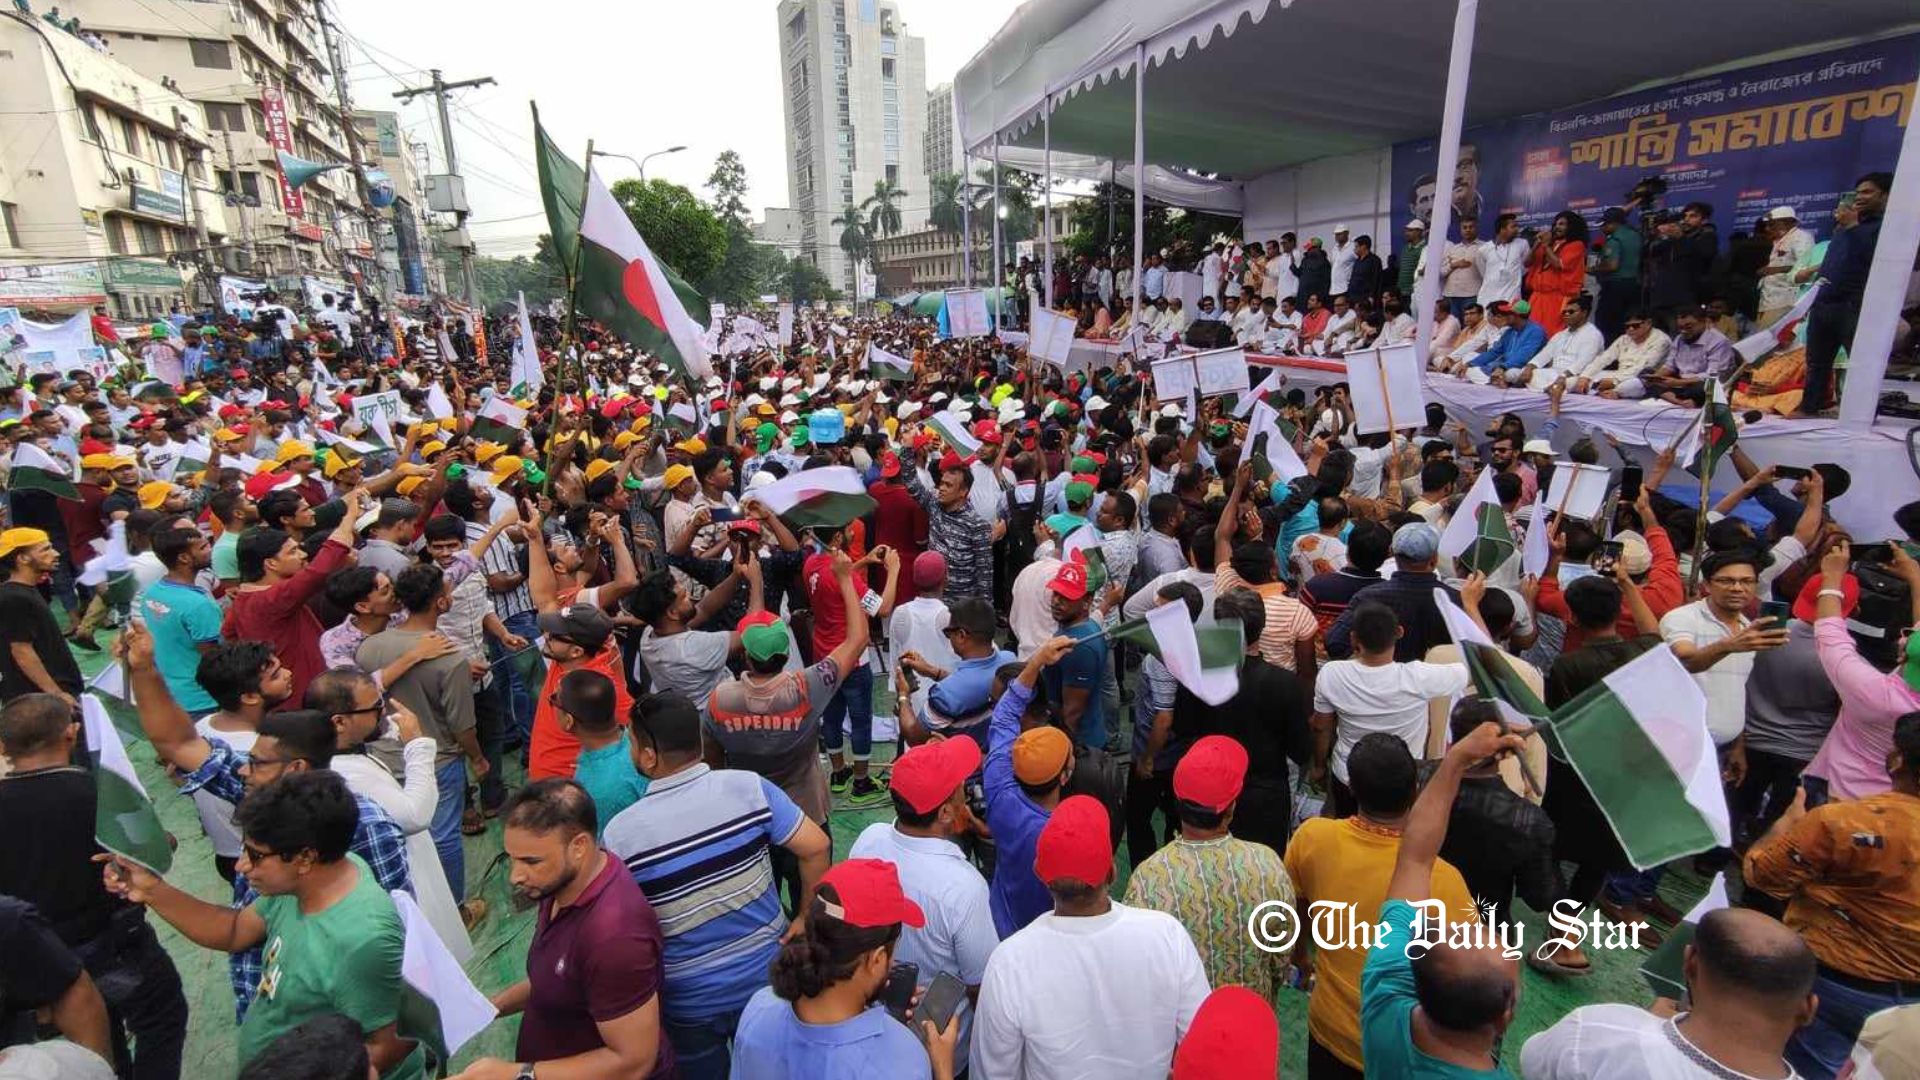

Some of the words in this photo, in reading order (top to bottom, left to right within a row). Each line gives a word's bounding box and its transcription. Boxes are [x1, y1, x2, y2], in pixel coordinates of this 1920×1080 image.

[1728, 85, 1738, 98] ও
[1816, 57, 1885, 82] প্রতিবাদে
[1568, 112, 1681, 170] শান্তি
[1687, 81, 1918, 158] সমাবেশ
[724, 714, 803, 733] SUPERDRY
